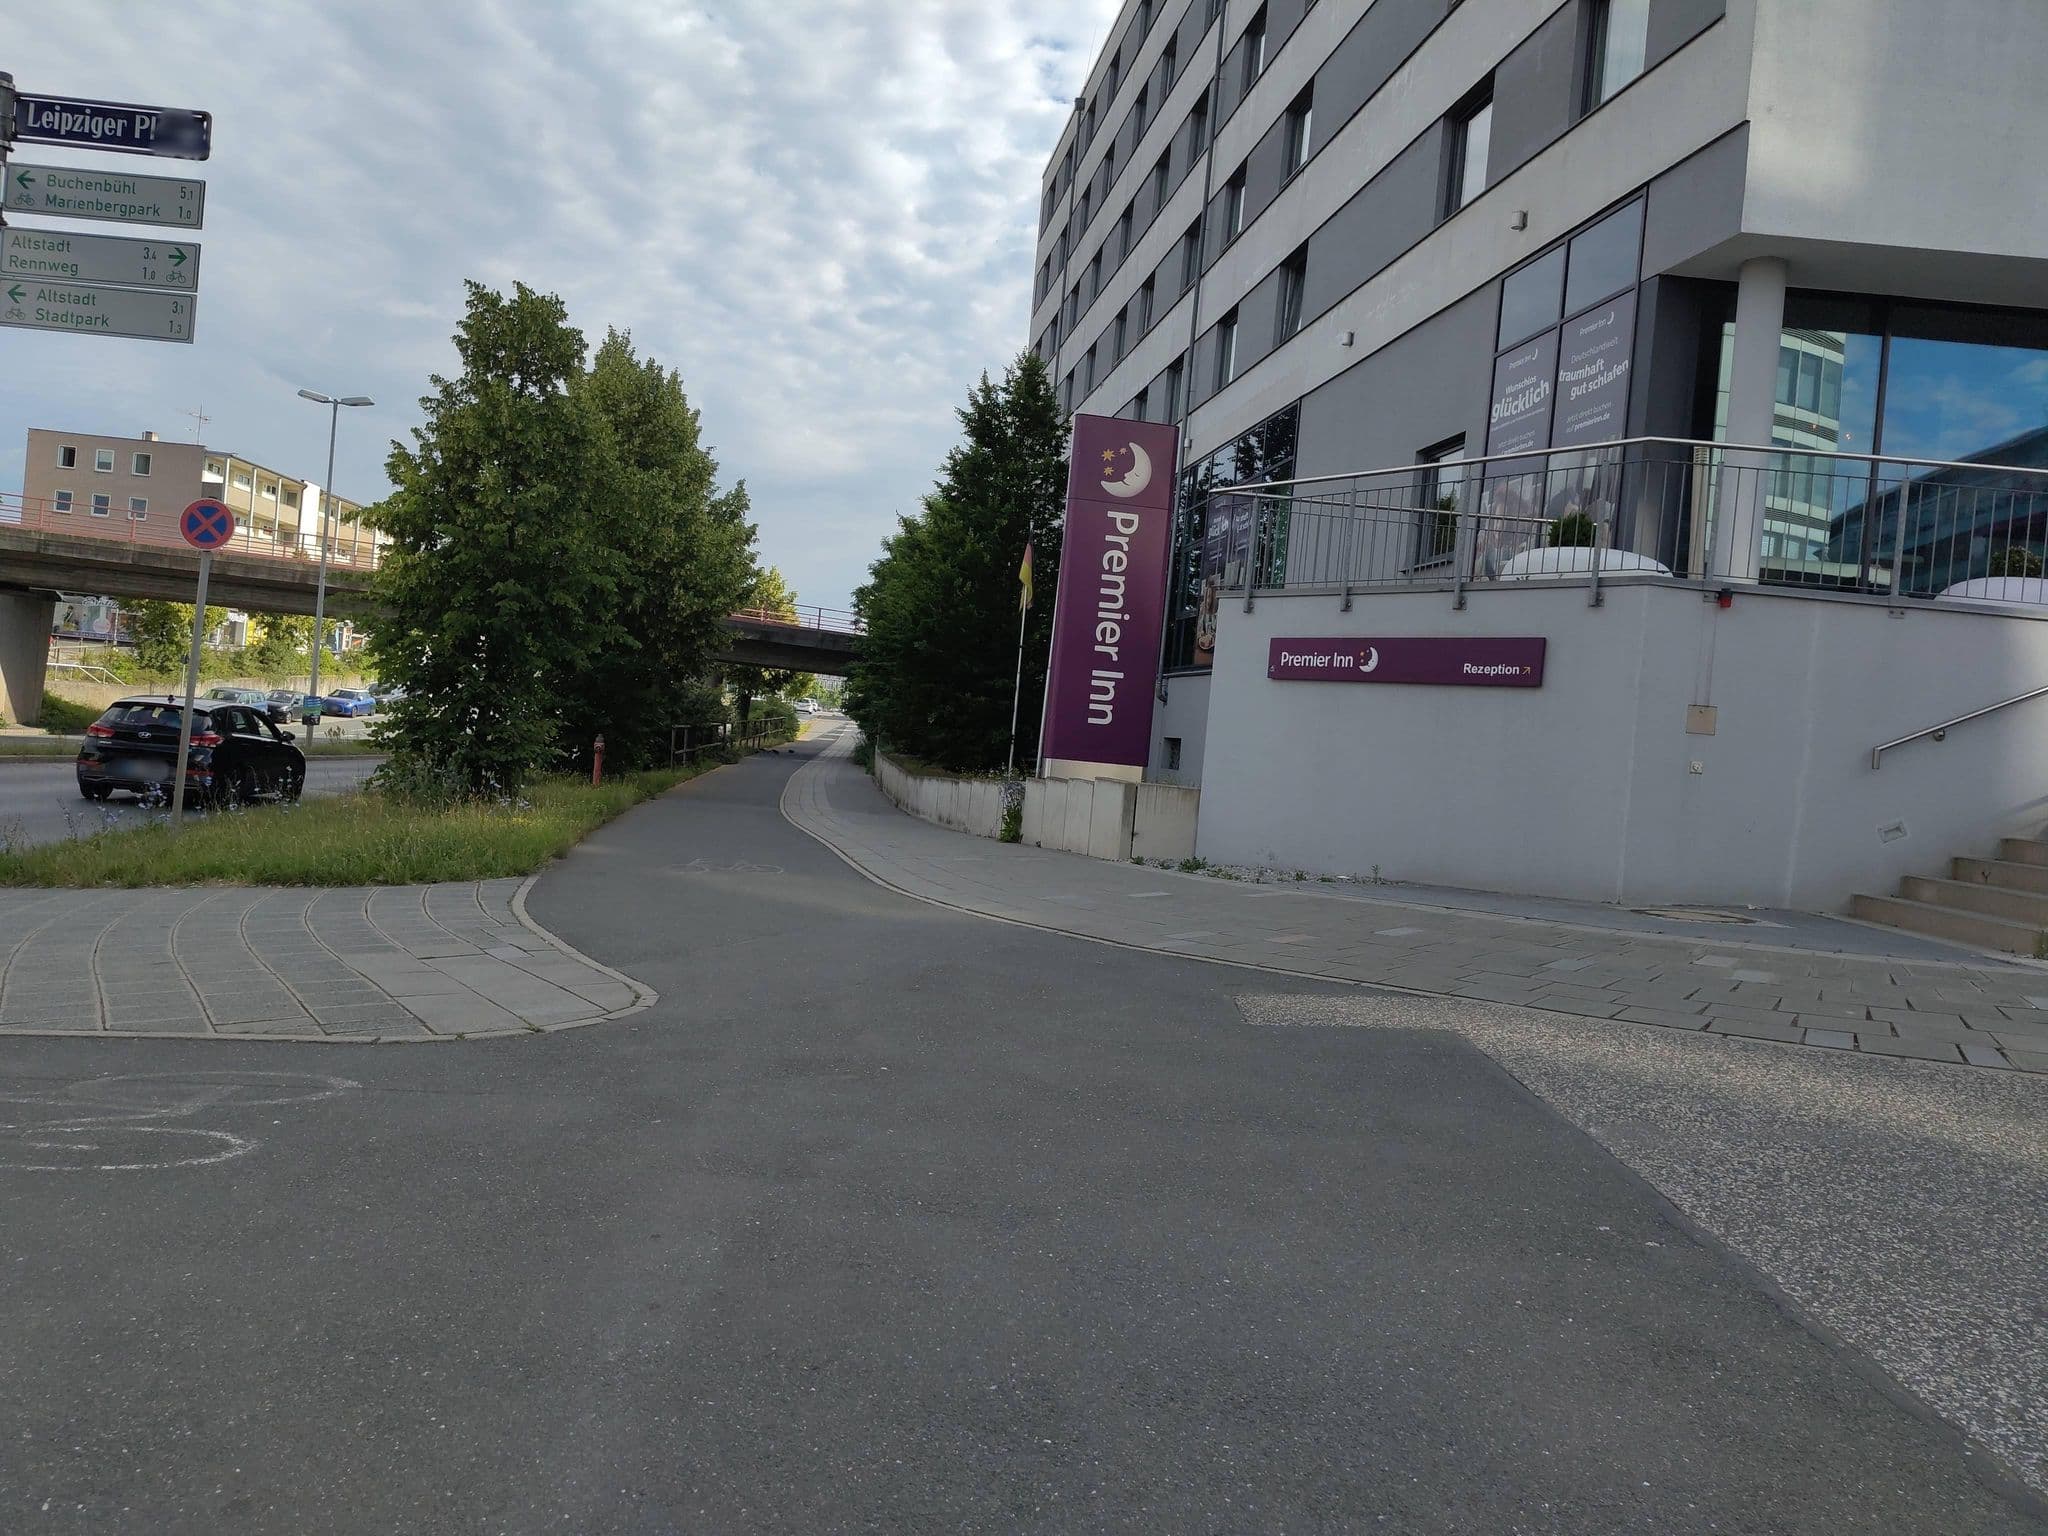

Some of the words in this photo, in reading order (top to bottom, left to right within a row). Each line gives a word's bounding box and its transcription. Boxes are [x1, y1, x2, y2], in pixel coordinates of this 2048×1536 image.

[27, 102, 128, 138] Leipziger
[46, 174, 137, 196] Buchenbühl
[45, 193, 161, 217] Marienbergpark
[10, 236, 71, 254] Altstadt
[9, 255, 79, 276] Rennweg
[36, 288, 97, 306] Altstadt
[35, 308, 110, 328] Stadtpark
[1559, 358, 1604, 382] traumhaft
[1570, 382, 1587, 400] gut
[1588, 359, 1629, 392] schlafen
[1505, 375, 1537, 395] Wunschlos
[1491, 380, 1550, 423] glücklich
[1091, 509, 1140, 662] Premier
[1280, 651, 1330, 668] Premier
[1333, 652, 1354, 668] Inn
[1463, 663, 1520, 677] Rezeption
[1087, 669, 1125, 727] Inn
